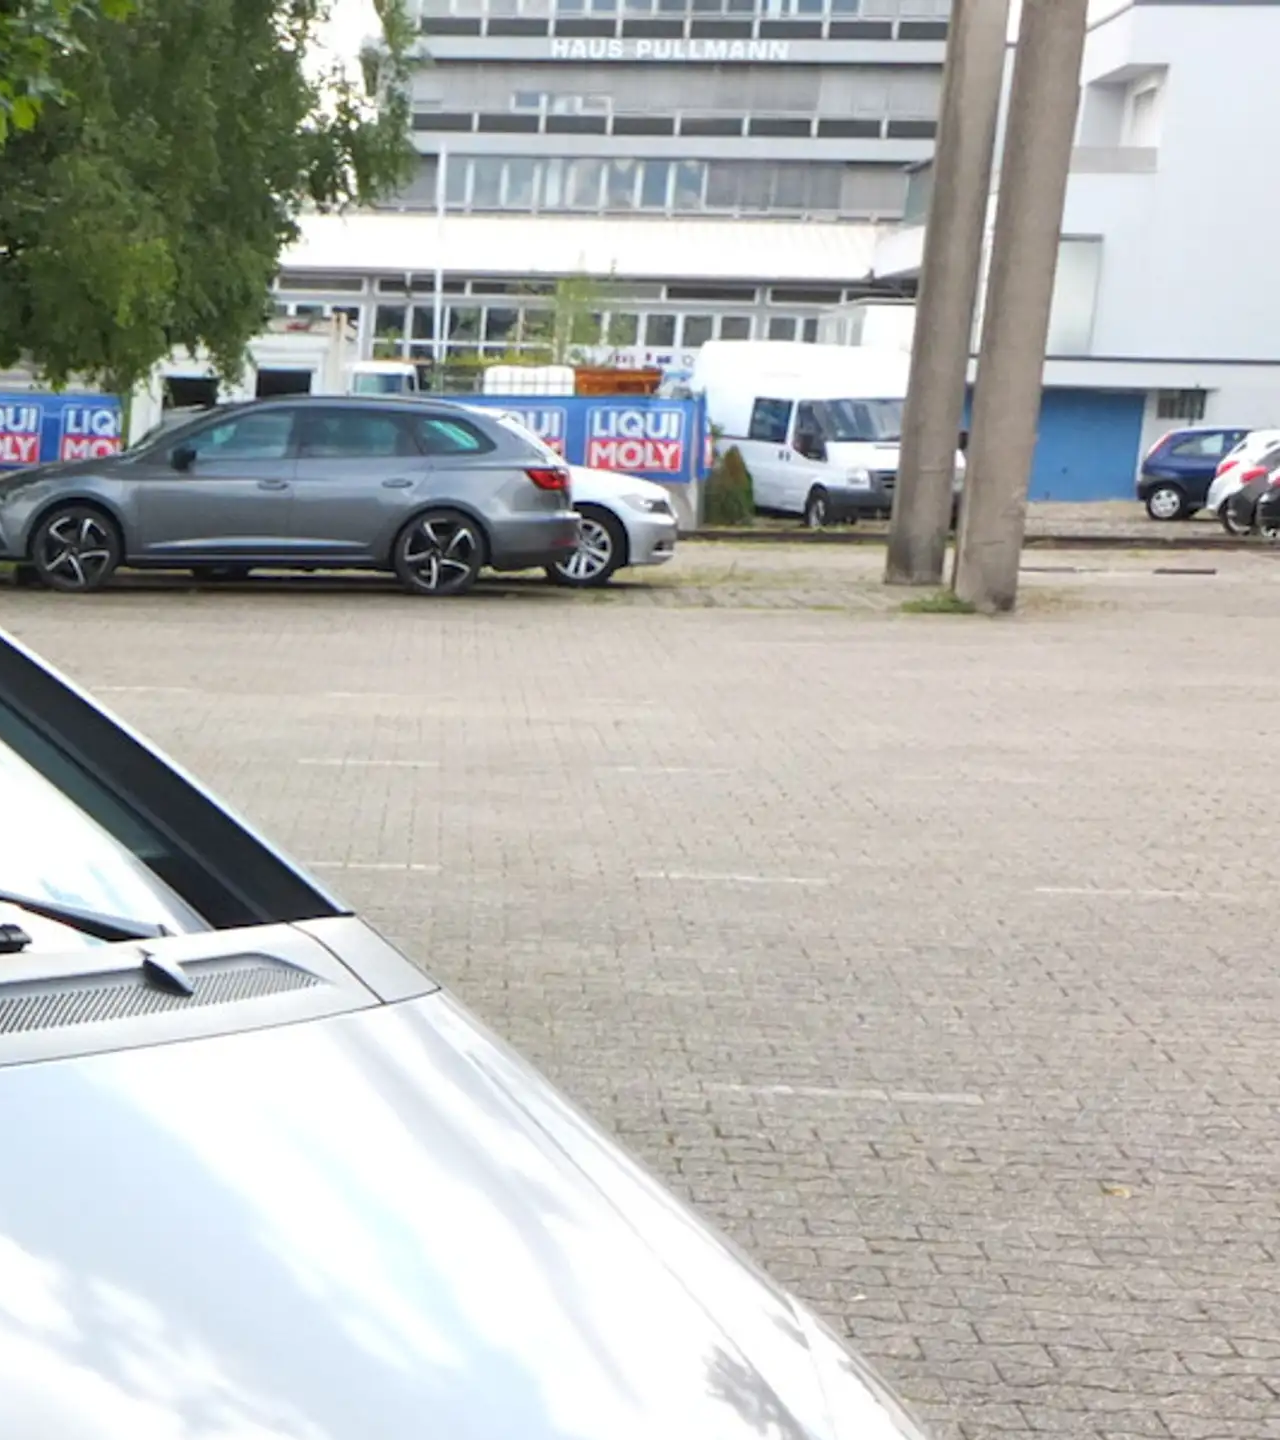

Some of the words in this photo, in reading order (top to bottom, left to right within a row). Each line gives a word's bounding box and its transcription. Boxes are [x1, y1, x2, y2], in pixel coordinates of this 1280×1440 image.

[551, 39, 623, 59] HAUS
[636, 40, 790, 60] PULLMANN
[593, 410, 679, 438] LIQUI
[590, 440, 680, 468] MOLY
